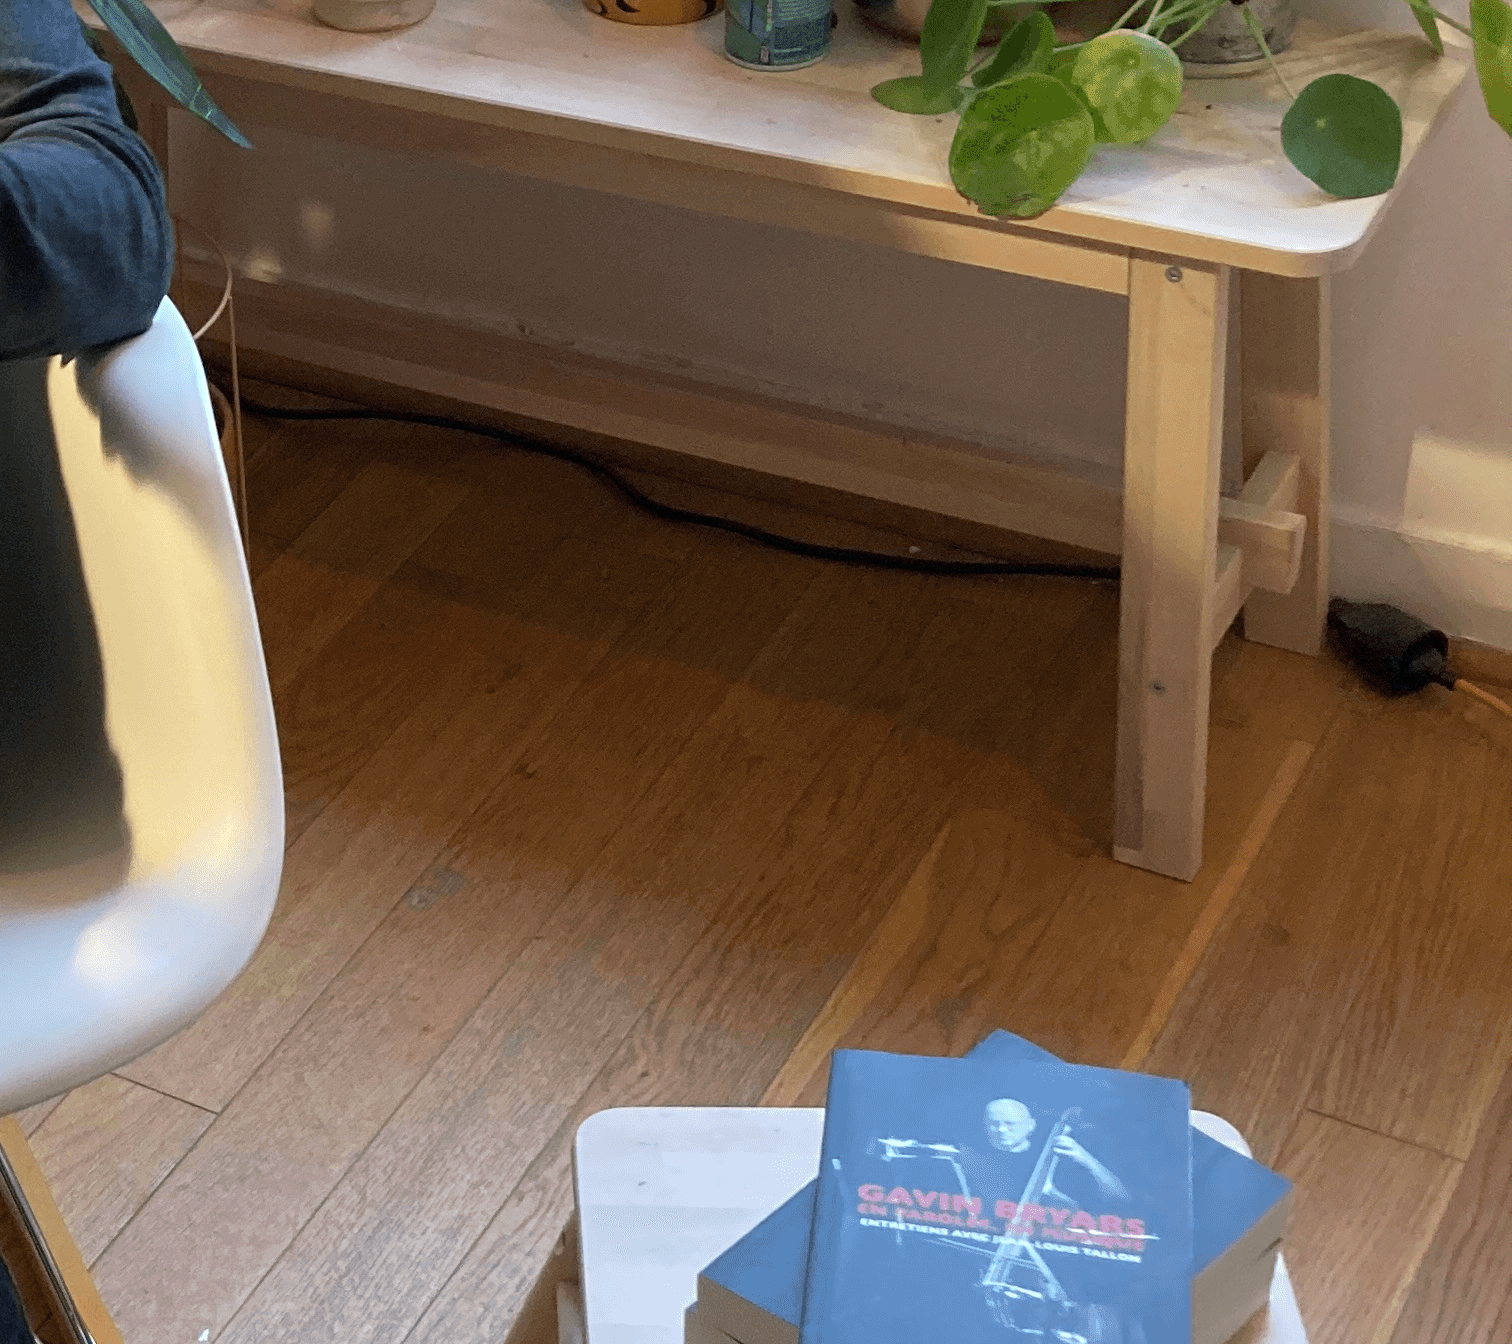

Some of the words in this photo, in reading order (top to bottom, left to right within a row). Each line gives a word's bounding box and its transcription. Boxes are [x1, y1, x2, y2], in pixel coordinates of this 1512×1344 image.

[857, 1183, 982, 1217] GAVIN
[995, 1200, 1145, 1234] BRYARS
[860, 1217, 949, 1236] ENTRETIENS
[951, 1229, 991, 1243] AVEC
[1082, 1247, 1142, 1264] TALLON
